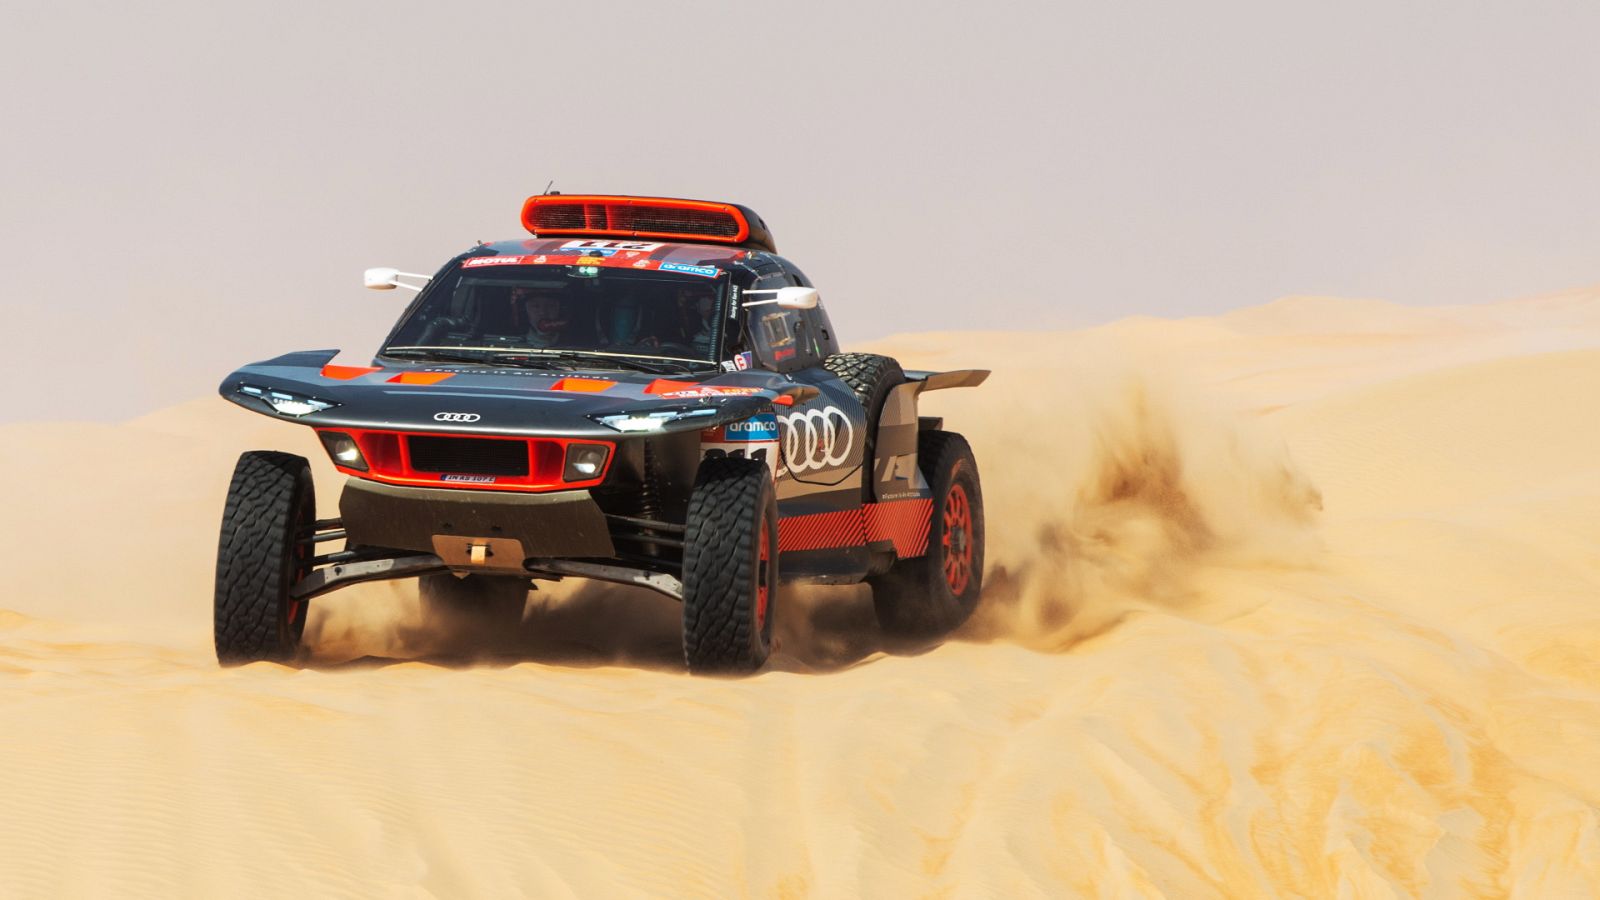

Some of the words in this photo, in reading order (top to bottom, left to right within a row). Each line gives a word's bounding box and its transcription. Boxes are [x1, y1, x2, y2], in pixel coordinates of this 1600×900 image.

[468, 256, 518, 266] MOTUL
[663, 263, 714, 276] aramco
[729, 421, 776, 432] aramco
